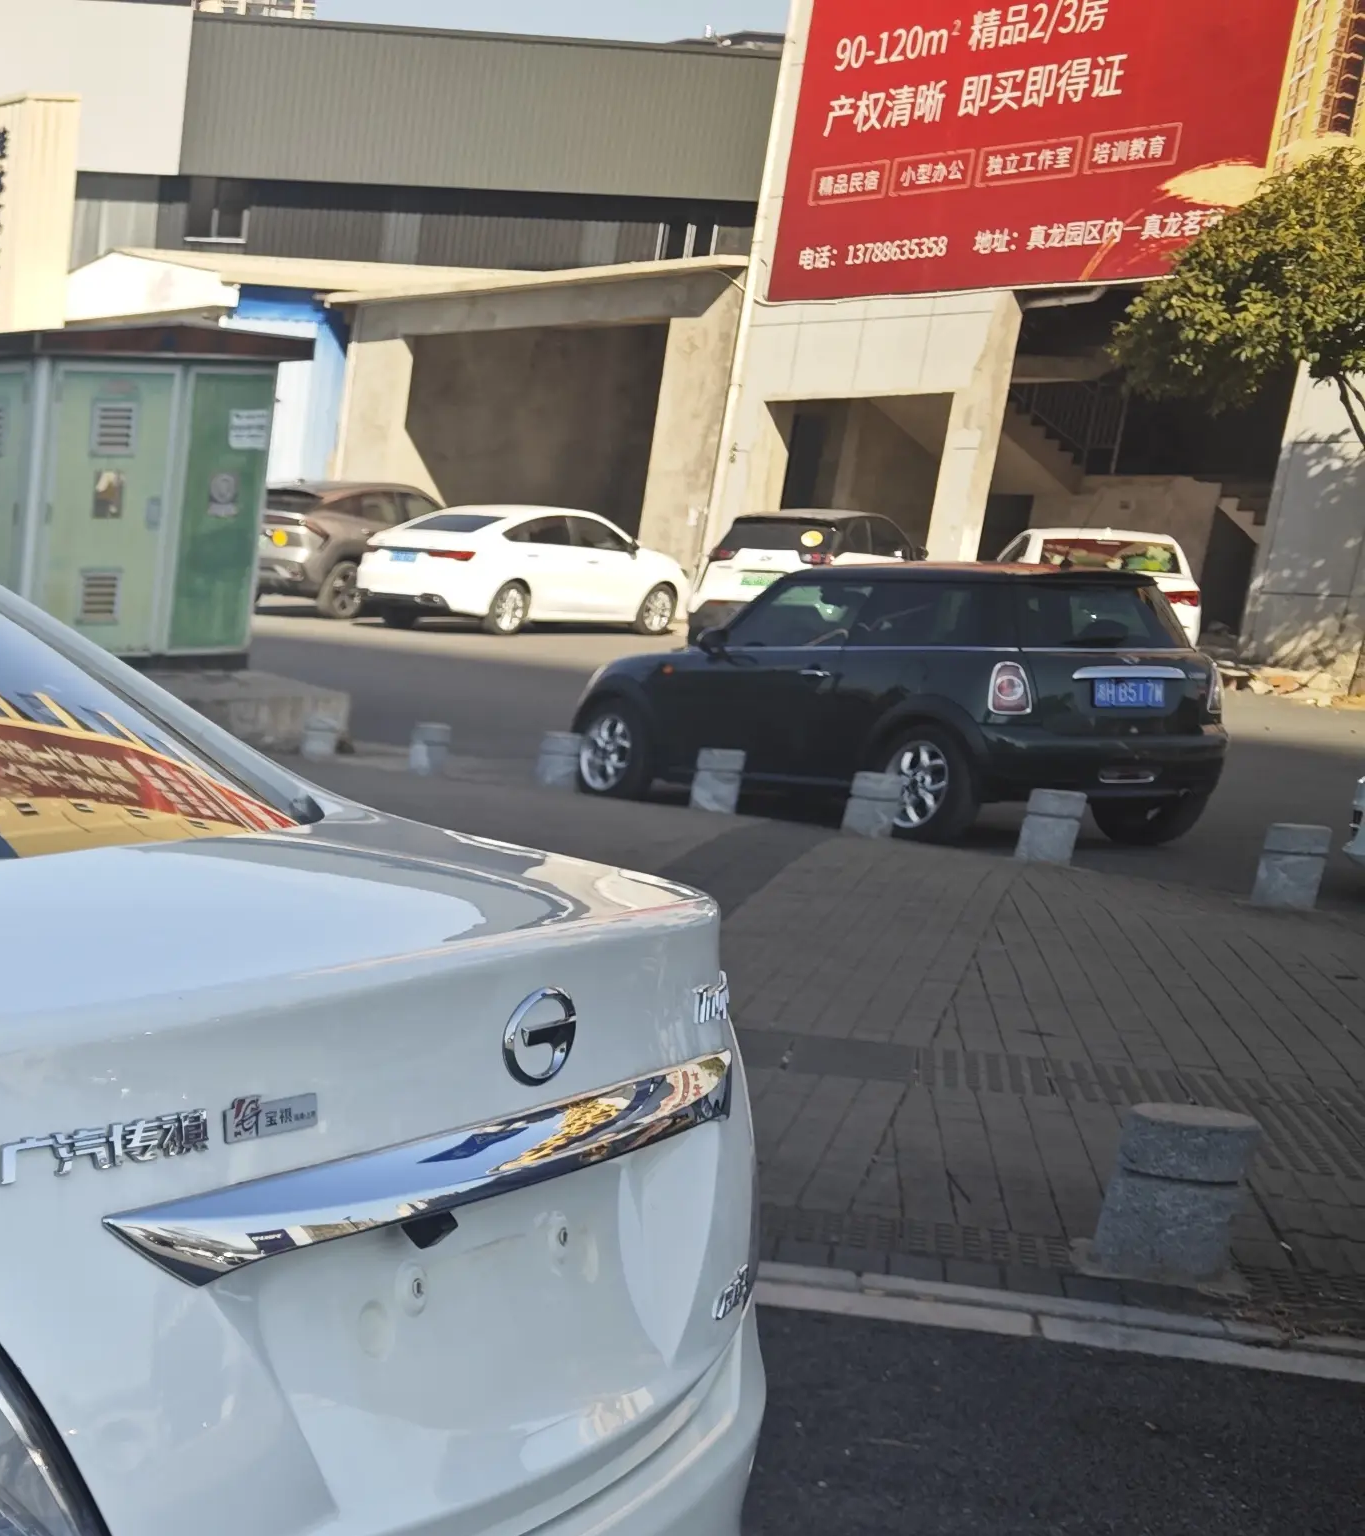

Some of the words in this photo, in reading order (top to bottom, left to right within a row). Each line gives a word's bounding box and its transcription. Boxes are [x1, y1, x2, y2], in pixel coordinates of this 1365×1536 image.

[967, 0, 1110, 52] 精品2/3房
[822, 79, 949, 138] 产权清晰
[956, 53, 1128, 118] 即买即得证
[985, 146, 1073, 178] 独立工作室
[1091, 134, 1167, 165] 培训教育
[817, 169, 881, 197] 精品民宿
[899, 159, 965, 187] 小型办公
